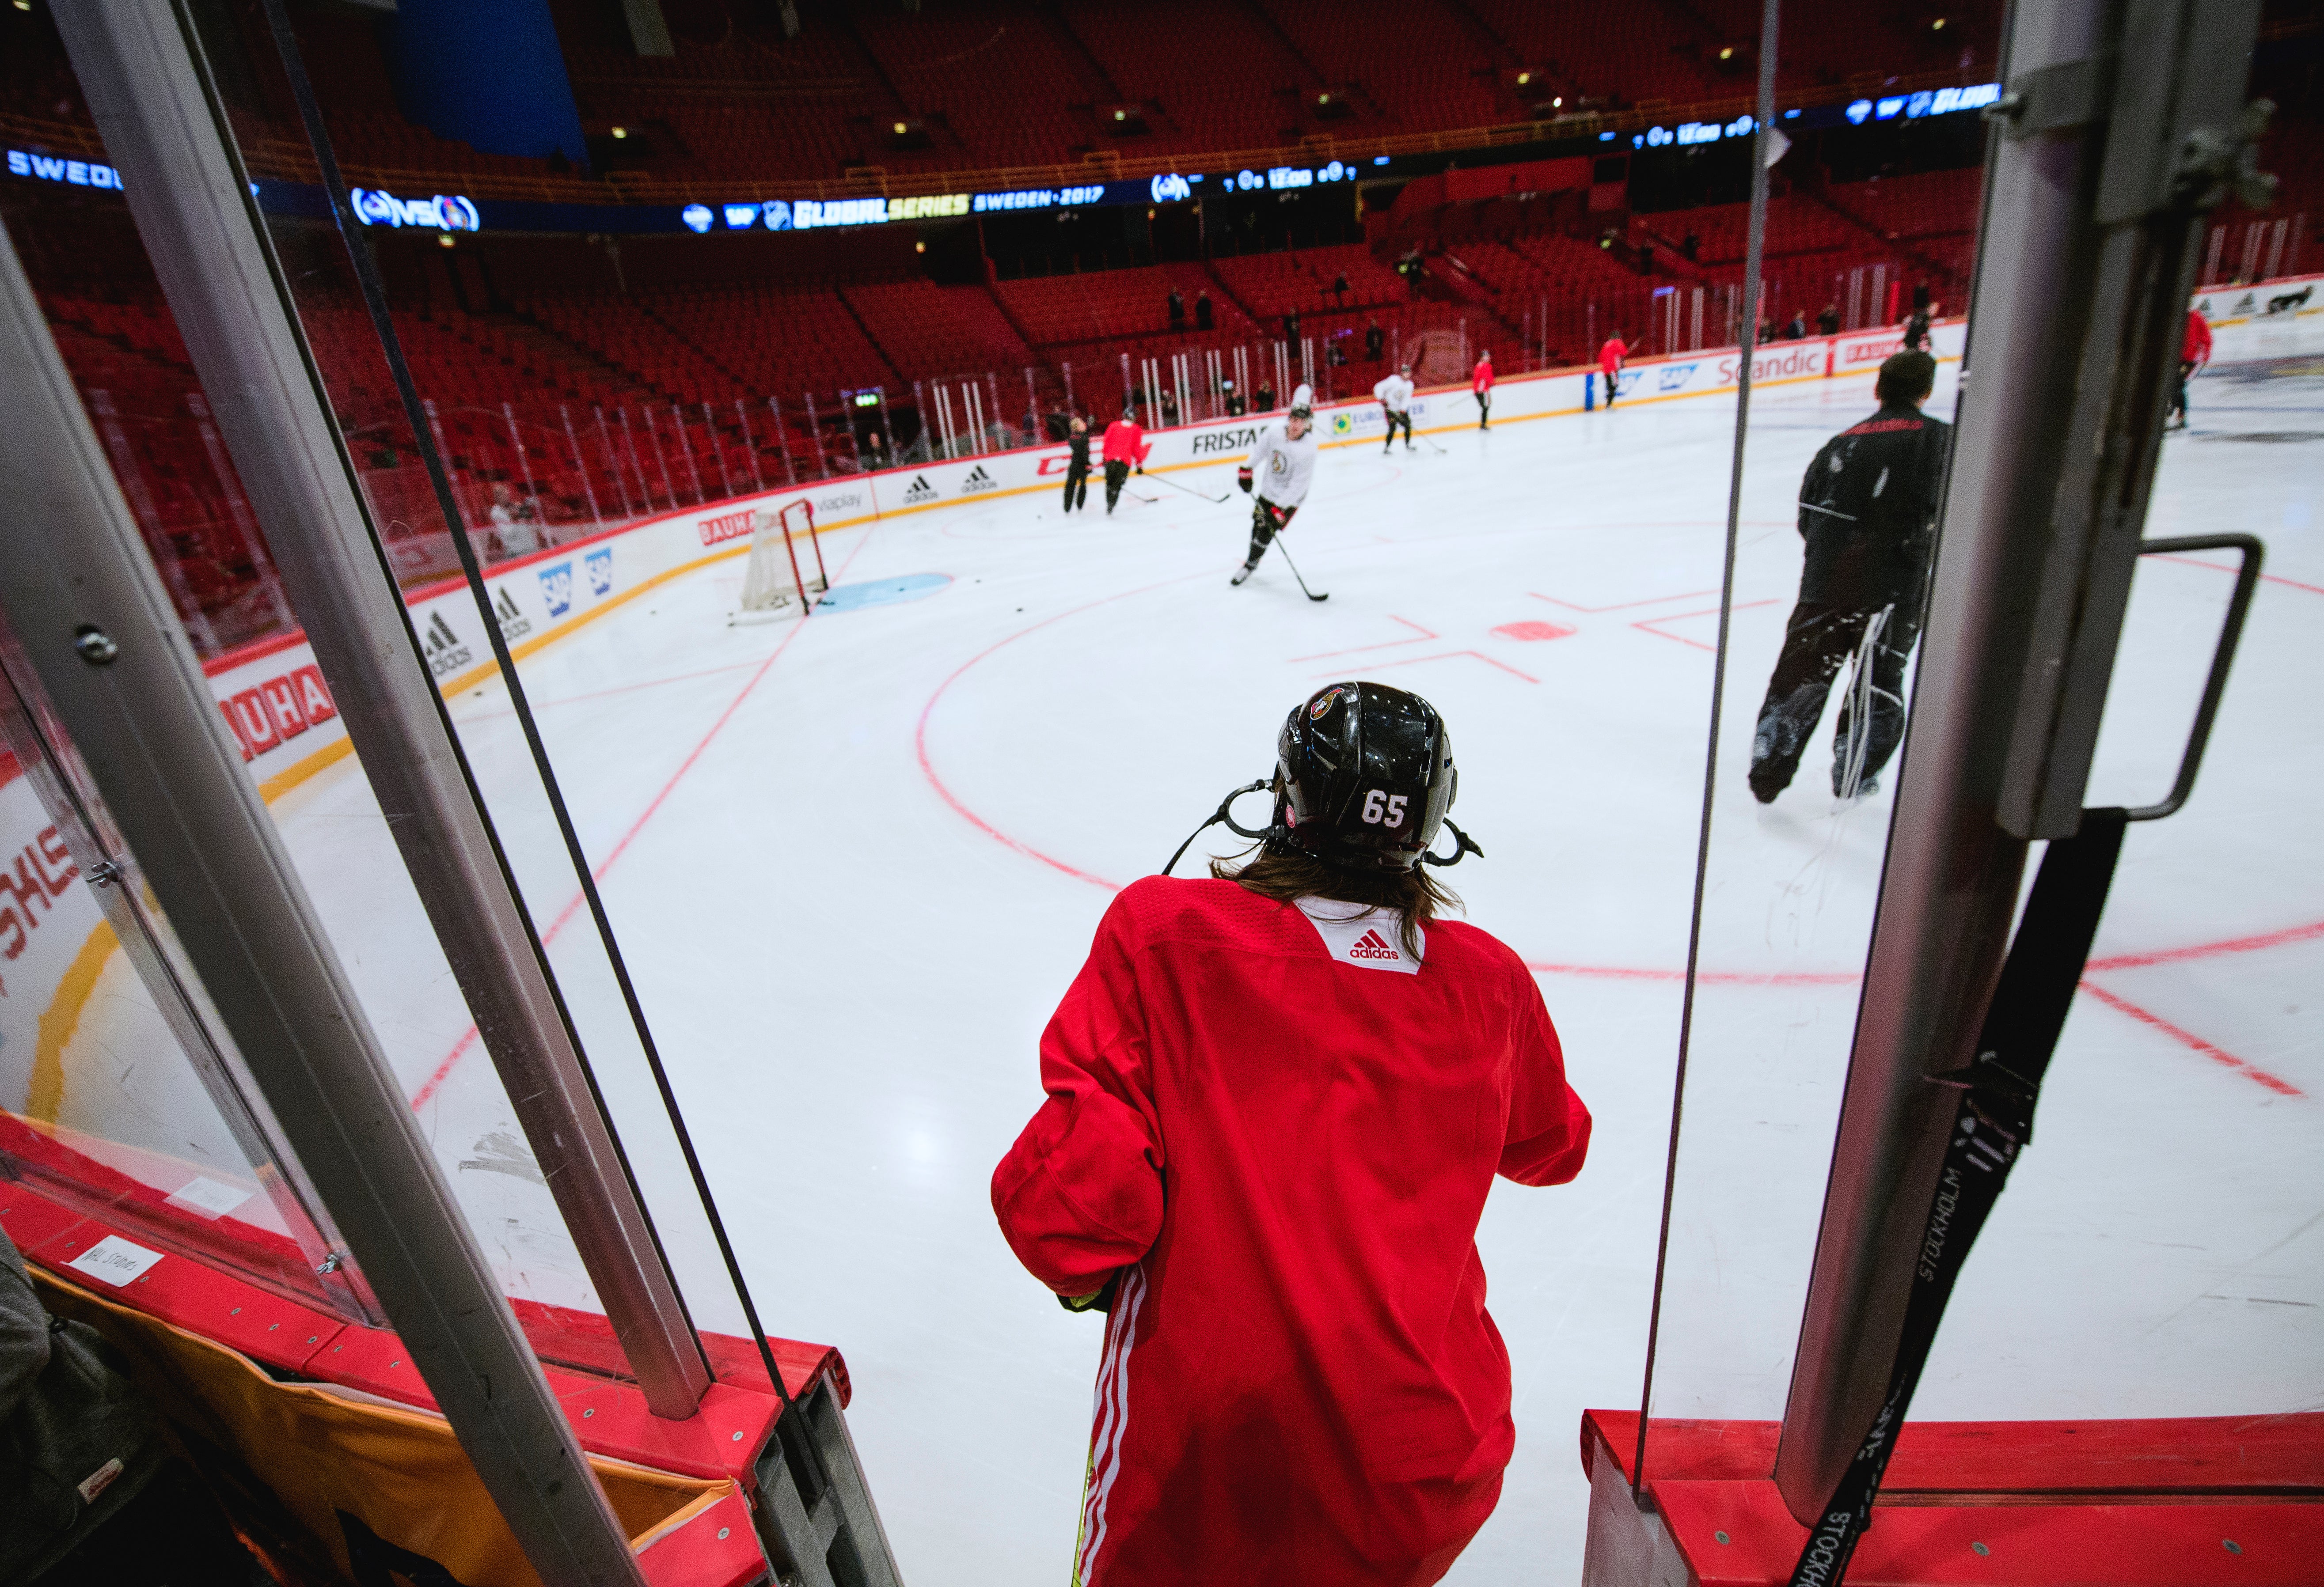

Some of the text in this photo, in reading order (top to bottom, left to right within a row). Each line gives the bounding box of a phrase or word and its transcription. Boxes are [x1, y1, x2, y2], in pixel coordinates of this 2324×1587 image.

[1930, 82, 2002, 115] GLOB
[793, 197, 888, 229] GLOBAL
[888, 193, 969, 220] SERIES
[816, 493, 861, 512] viaplay
[231, 669, 334, 753] UHA
[1362, 789, 1408, 828] 65
[1350, 947, 1399, 960] adidas
[1918, 1167, 1962, 1282] STOCKHOLM
